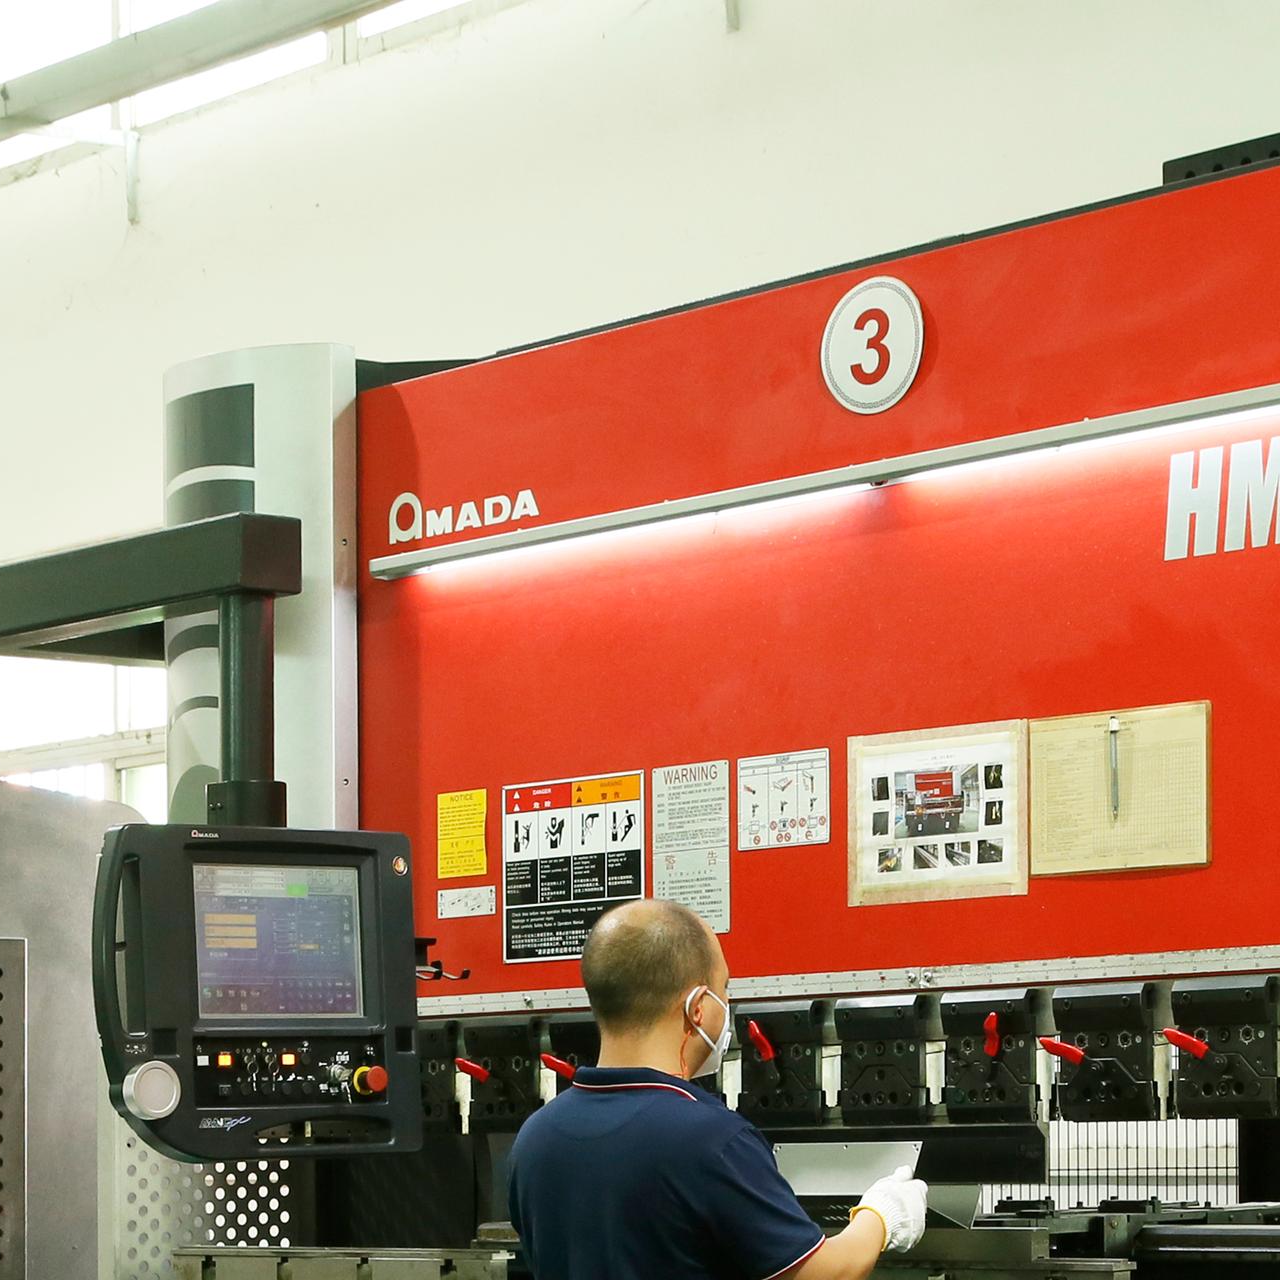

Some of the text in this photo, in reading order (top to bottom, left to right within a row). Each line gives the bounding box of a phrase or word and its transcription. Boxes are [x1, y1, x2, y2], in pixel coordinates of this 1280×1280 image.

[850, 308, 891, 386] 3
[388, 489, 540, 545] AMADA
[663, 764, 718, 785] WARNING
[450, 793, 473, 802] NOTICE
